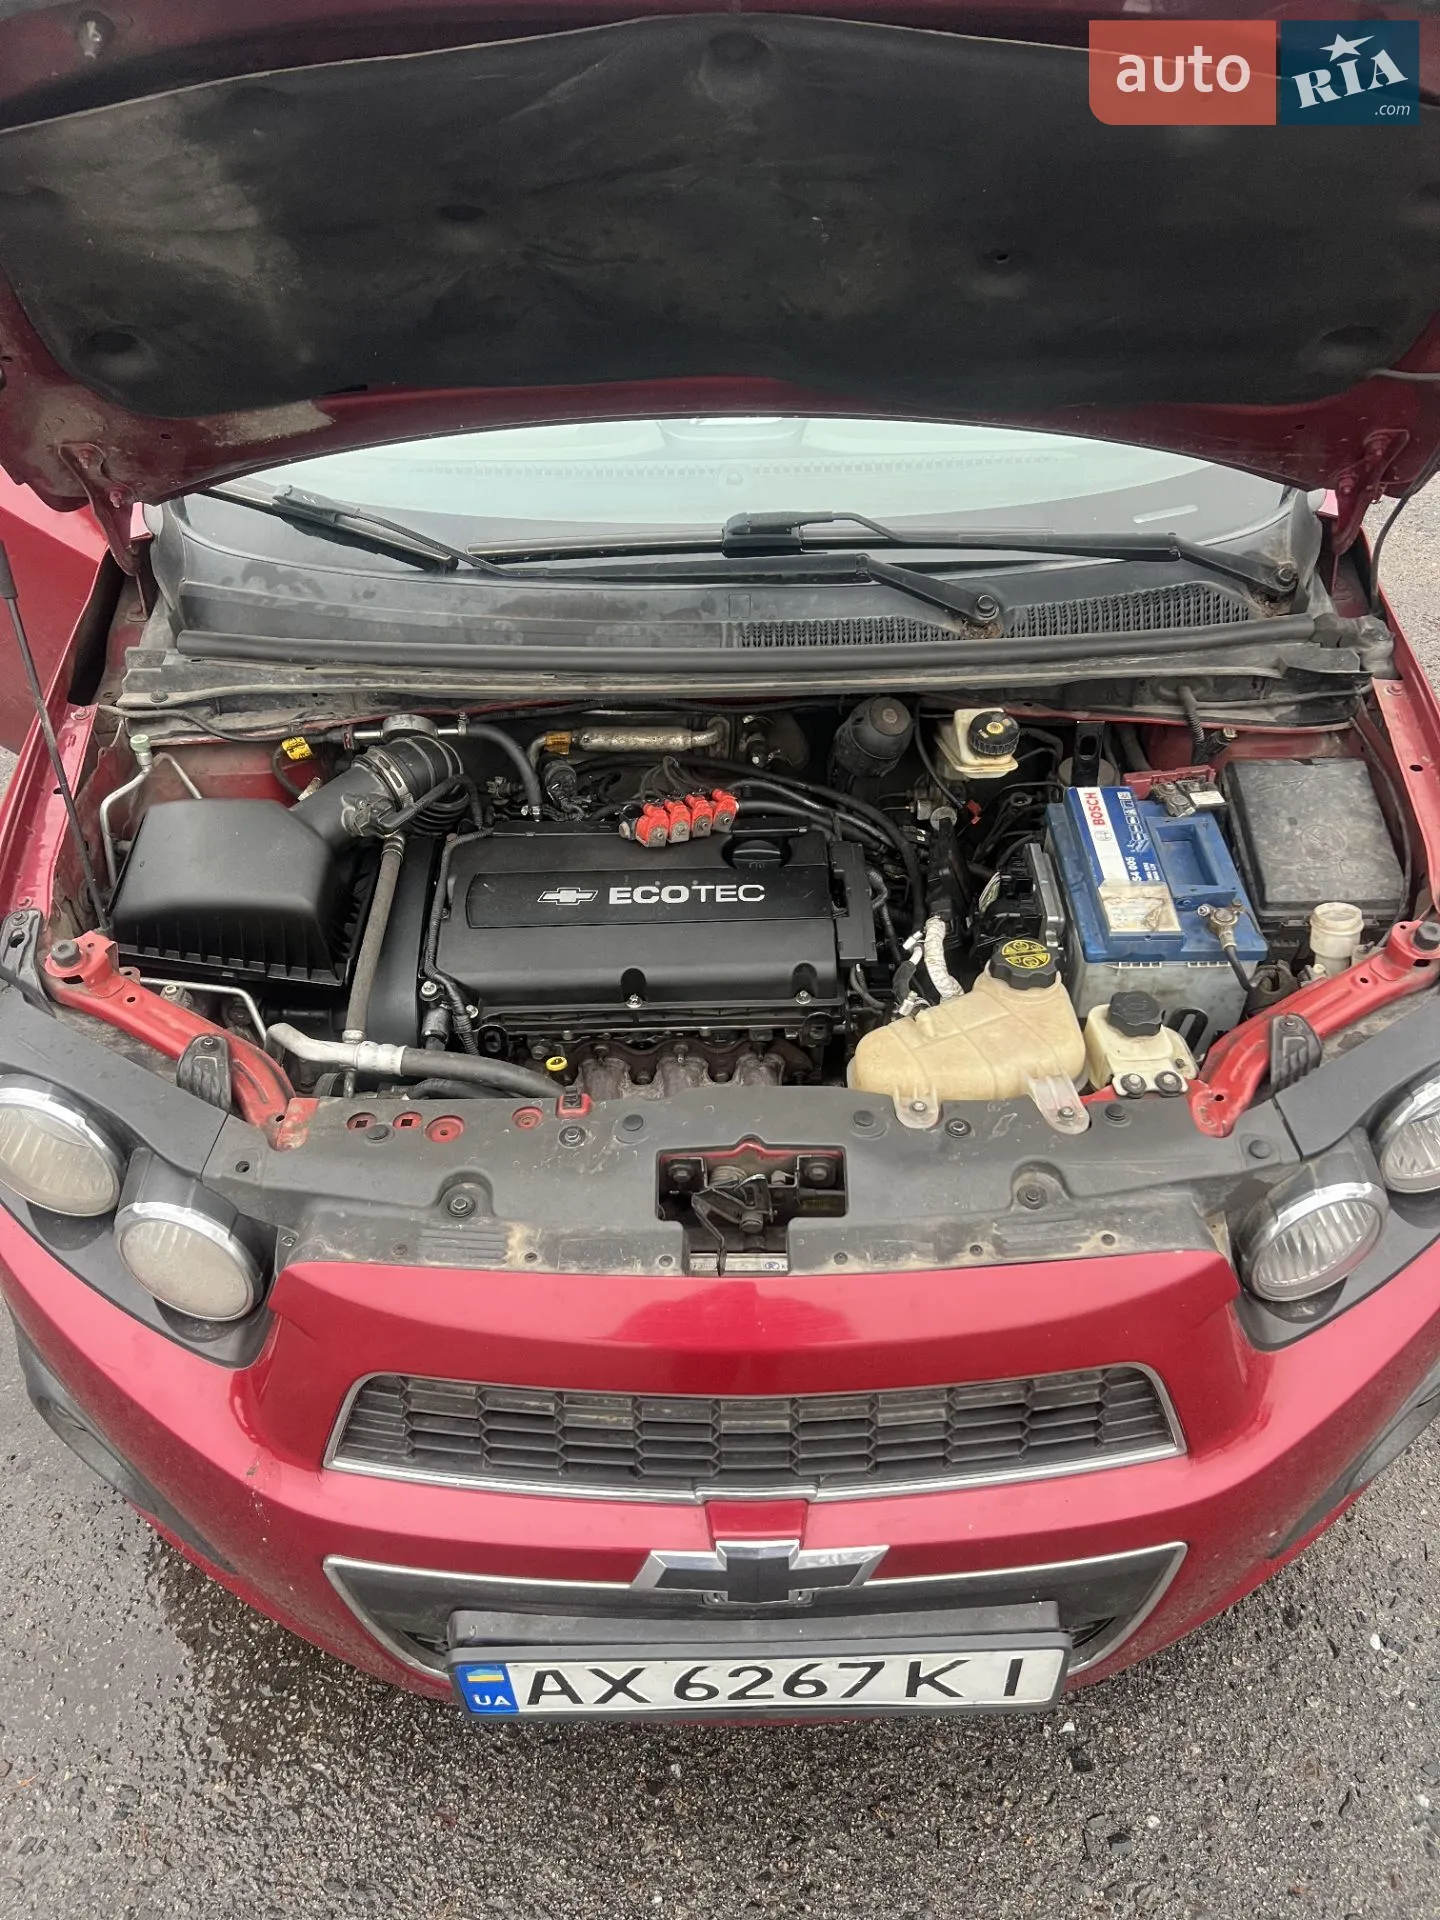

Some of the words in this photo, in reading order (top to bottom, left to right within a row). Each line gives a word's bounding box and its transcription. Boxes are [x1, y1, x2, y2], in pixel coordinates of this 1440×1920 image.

[1084, 792, 1106, 826] BOSCH
[608, 884, 766, 905] ECOTEC
[526, 1667, 651, 1706] AX
[674, 1660, 885, 1702] 6267
[474, 1694, 512, 1706] UA
